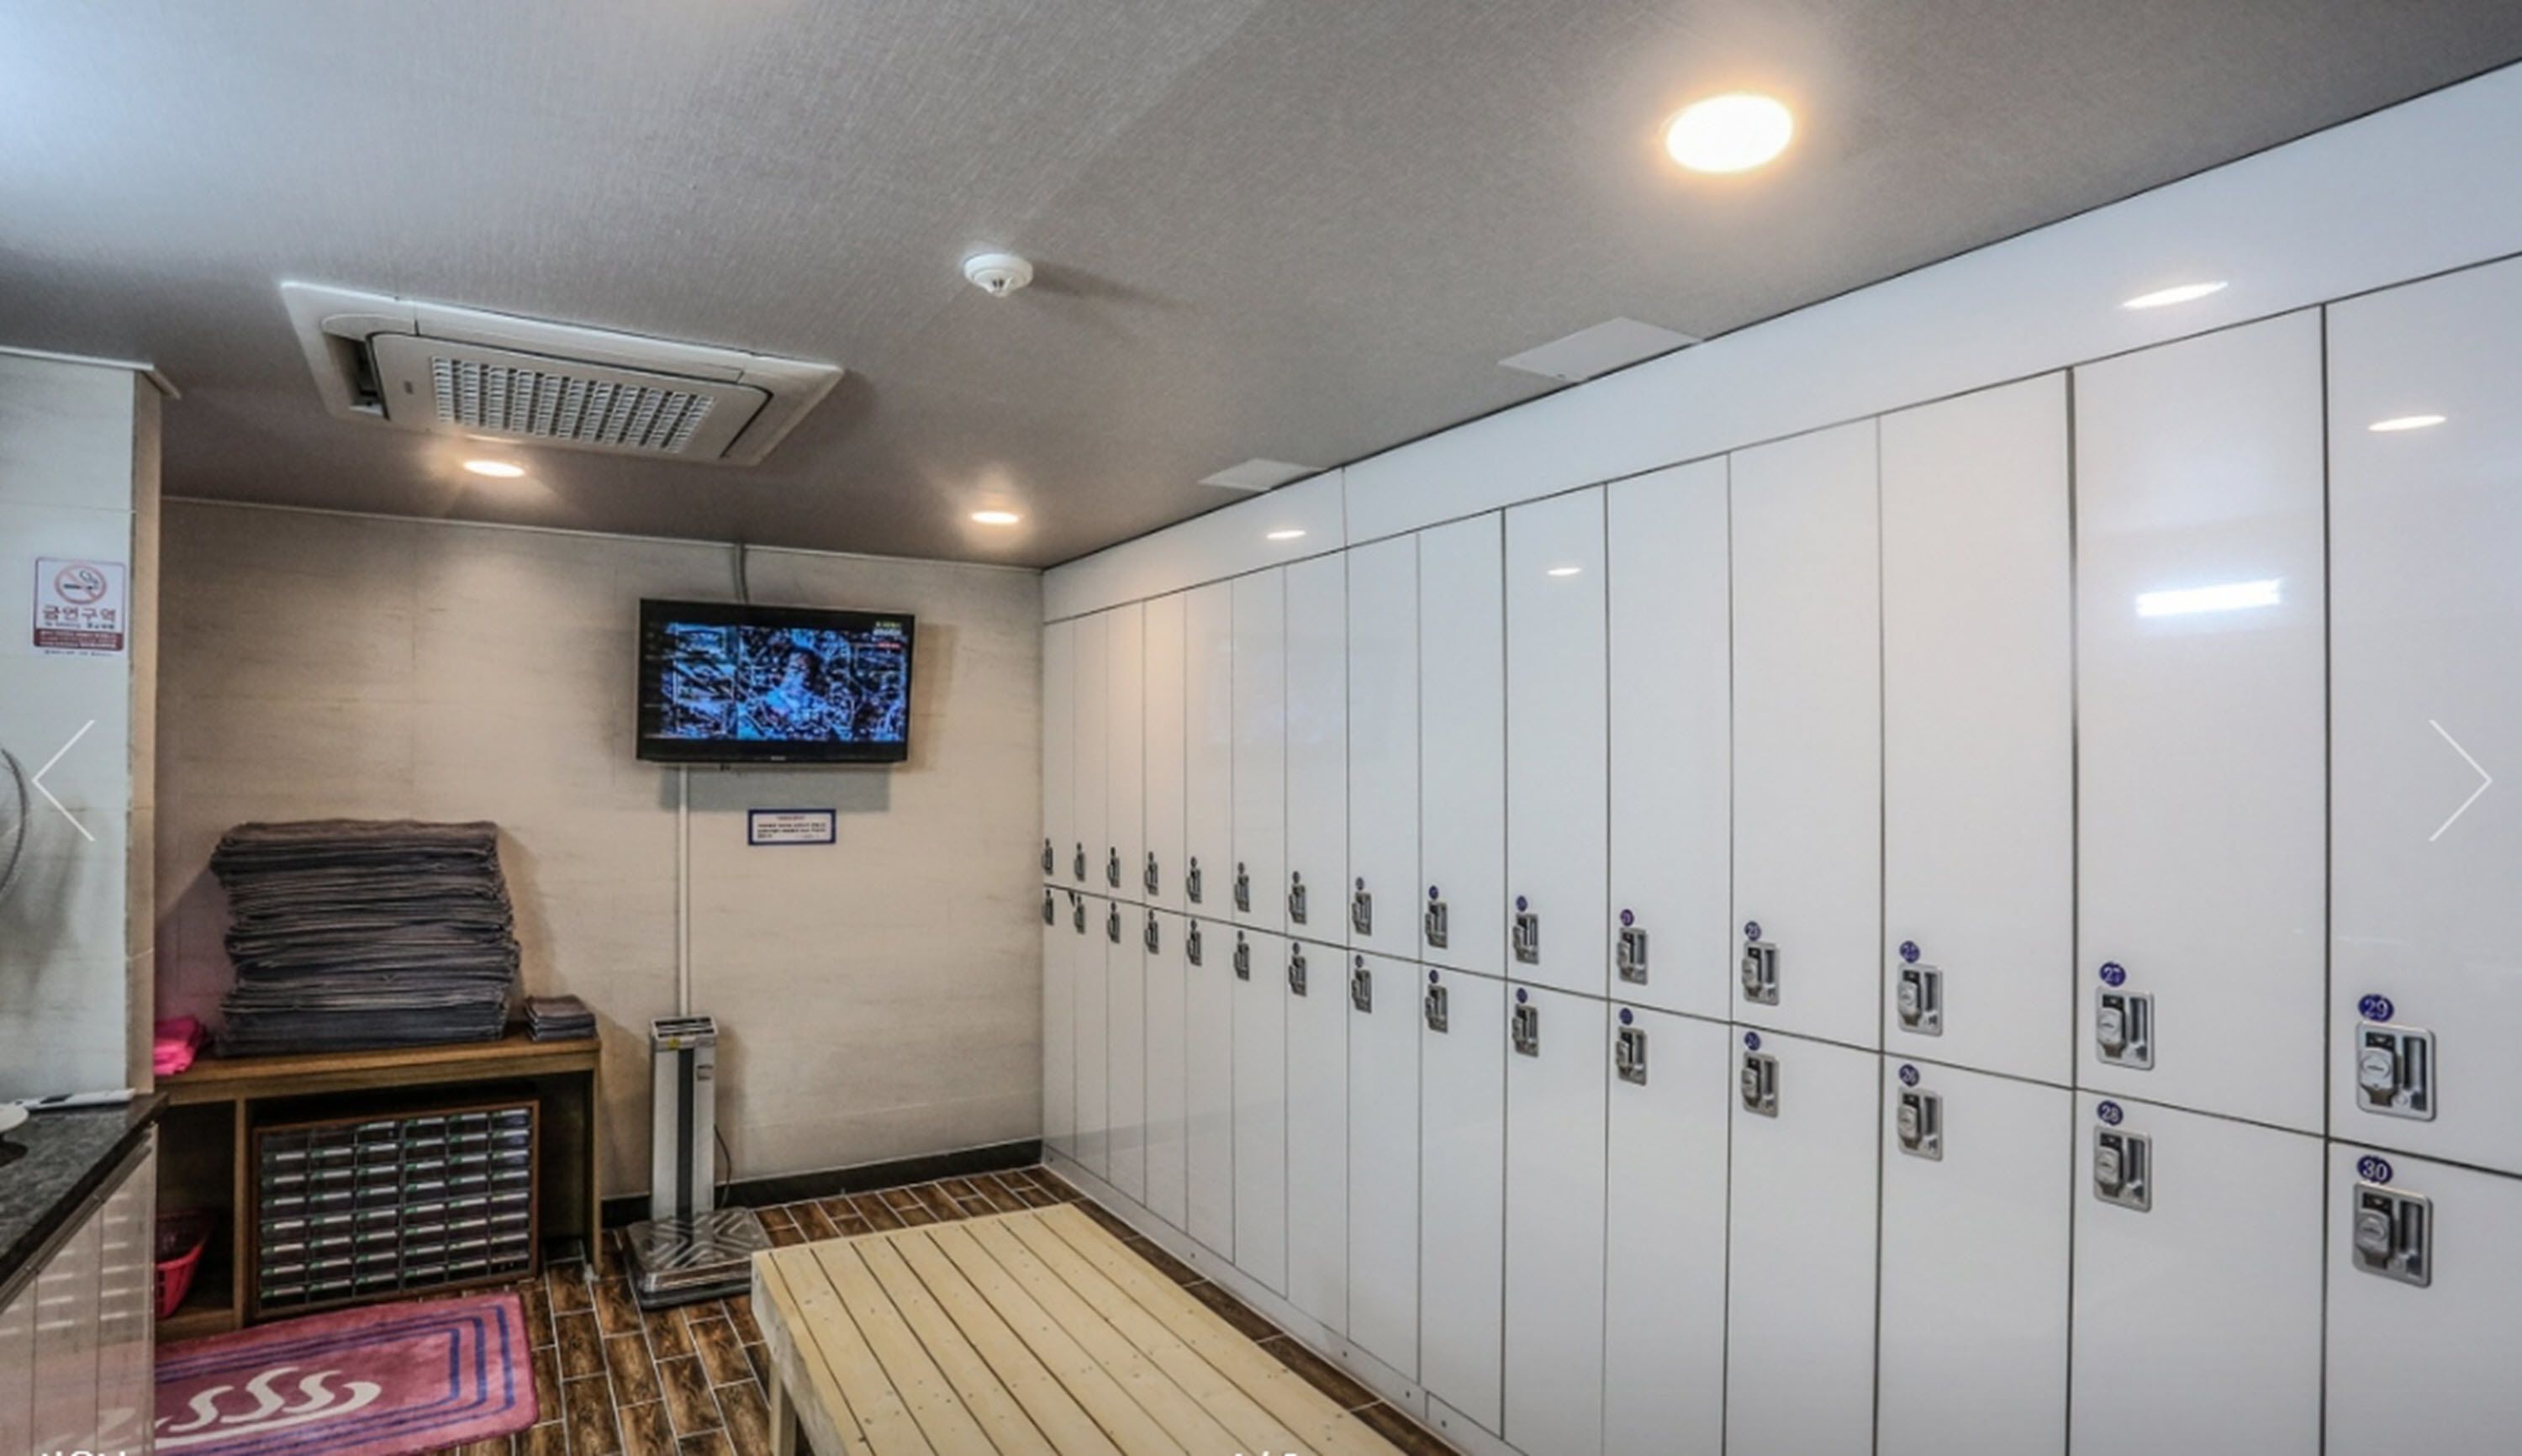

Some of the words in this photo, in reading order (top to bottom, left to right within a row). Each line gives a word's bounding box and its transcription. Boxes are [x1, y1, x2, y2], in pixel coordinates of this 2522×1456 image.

[43, 604, 116, 623] 금연구역
[2103, 966, 2121, 984] 27
[2363, 997, 2389, 1020] 29
[2102, 1105, 2119, 1121] 28
[2362, 1158, 2388, 1182] 30
